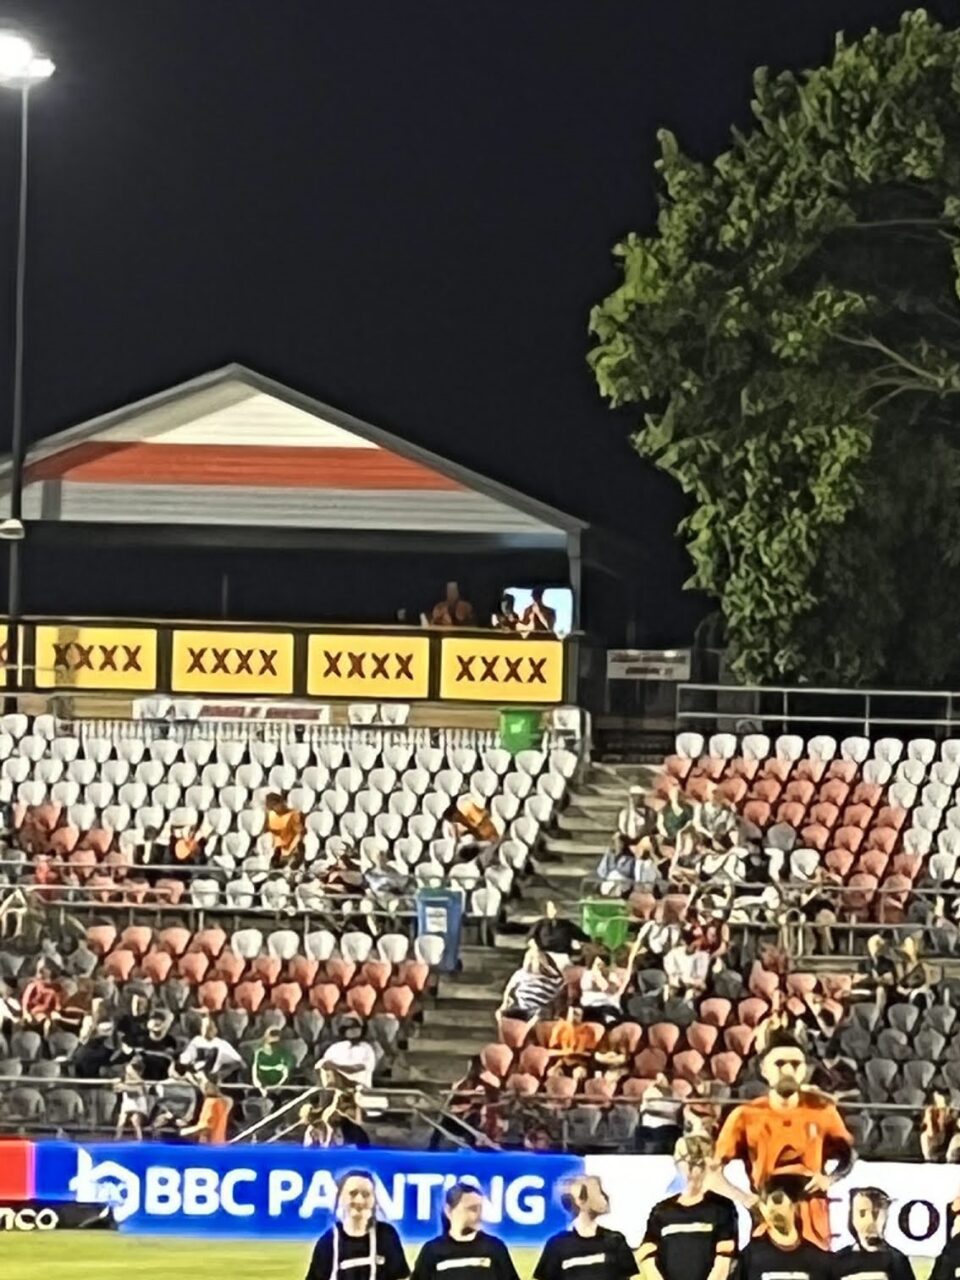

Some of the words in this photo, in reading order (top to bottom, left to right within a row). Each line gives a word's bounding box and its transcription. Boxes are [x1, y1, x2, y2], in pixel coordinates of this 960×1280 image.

[53, 643, 142, 671] XXXX
[186, 647, 277, 676] XXXX
[323, 650, 413, 680] XXXX
[456, 655, 547, 683] XXXX
[145, 1166, 257, 1216] BBC
[268, 1169, 545, 1225] PANTNG
